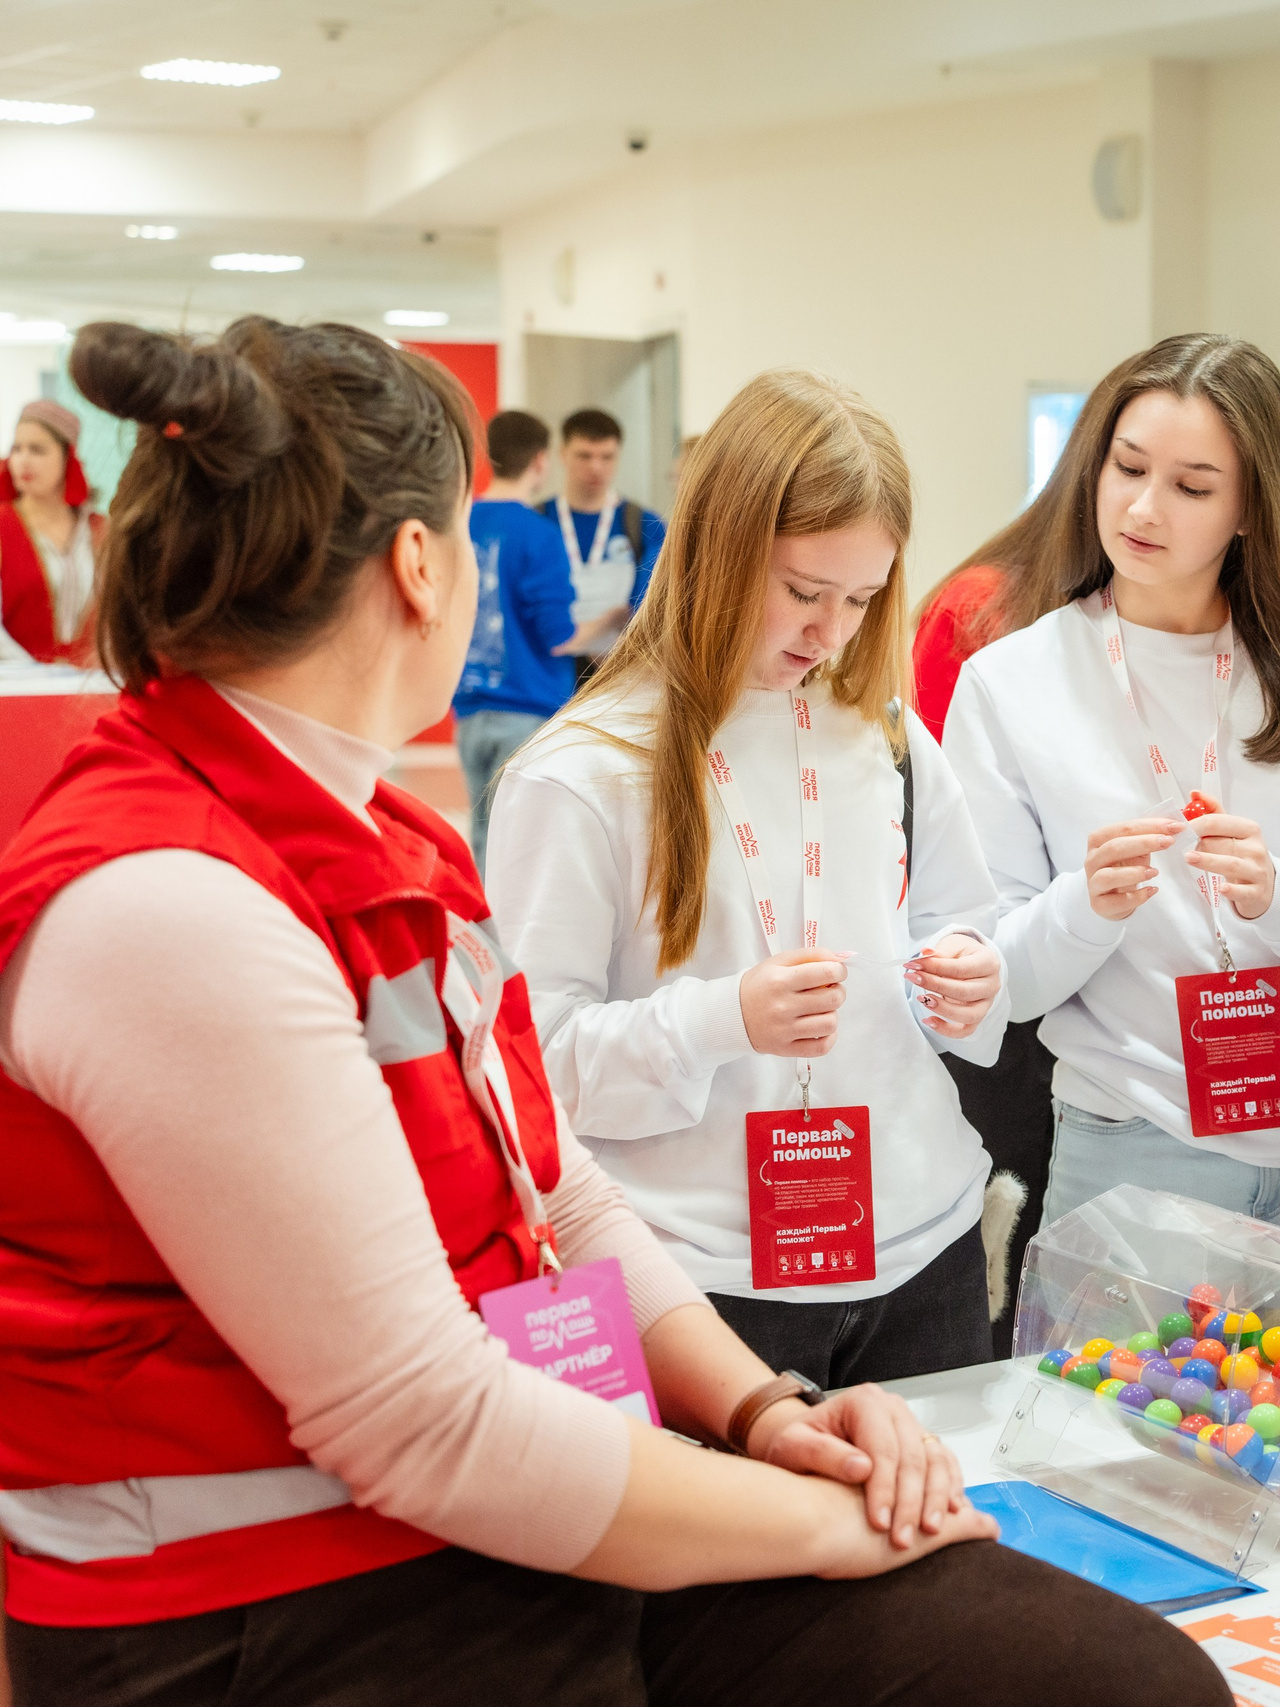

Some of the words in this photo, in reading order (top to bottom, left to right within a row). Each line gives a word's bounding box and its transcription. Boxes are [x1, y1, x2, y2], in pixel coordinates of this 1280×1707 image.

[801, 699, 811, 730] первая
[1154, 745, 1168, 773] первая
[810, 768, 818, 801] первая
[735, 824, 751, 859] первая
[758, 900, 771, 936] первая
[1200, 988, 1266, 1006] Первая
[1202, 1002, 1276, 1021] помощь
[1210, 1078, 1243, 1089] каждый
[1244, 1074, 1276, 1085] Первый
[1211, 1086, 1247, 1096] поможет
[772, 1129, 843, 1147] Первая
[773, 1146, 852, 1162] помощь
[776, 1226, 811, 1237] каждый
[812, 1223, 847, 1235] Первый
[776, 1236, 815, 1245] поможет
[541, 1344, 613, 1380] АРТНЁР
